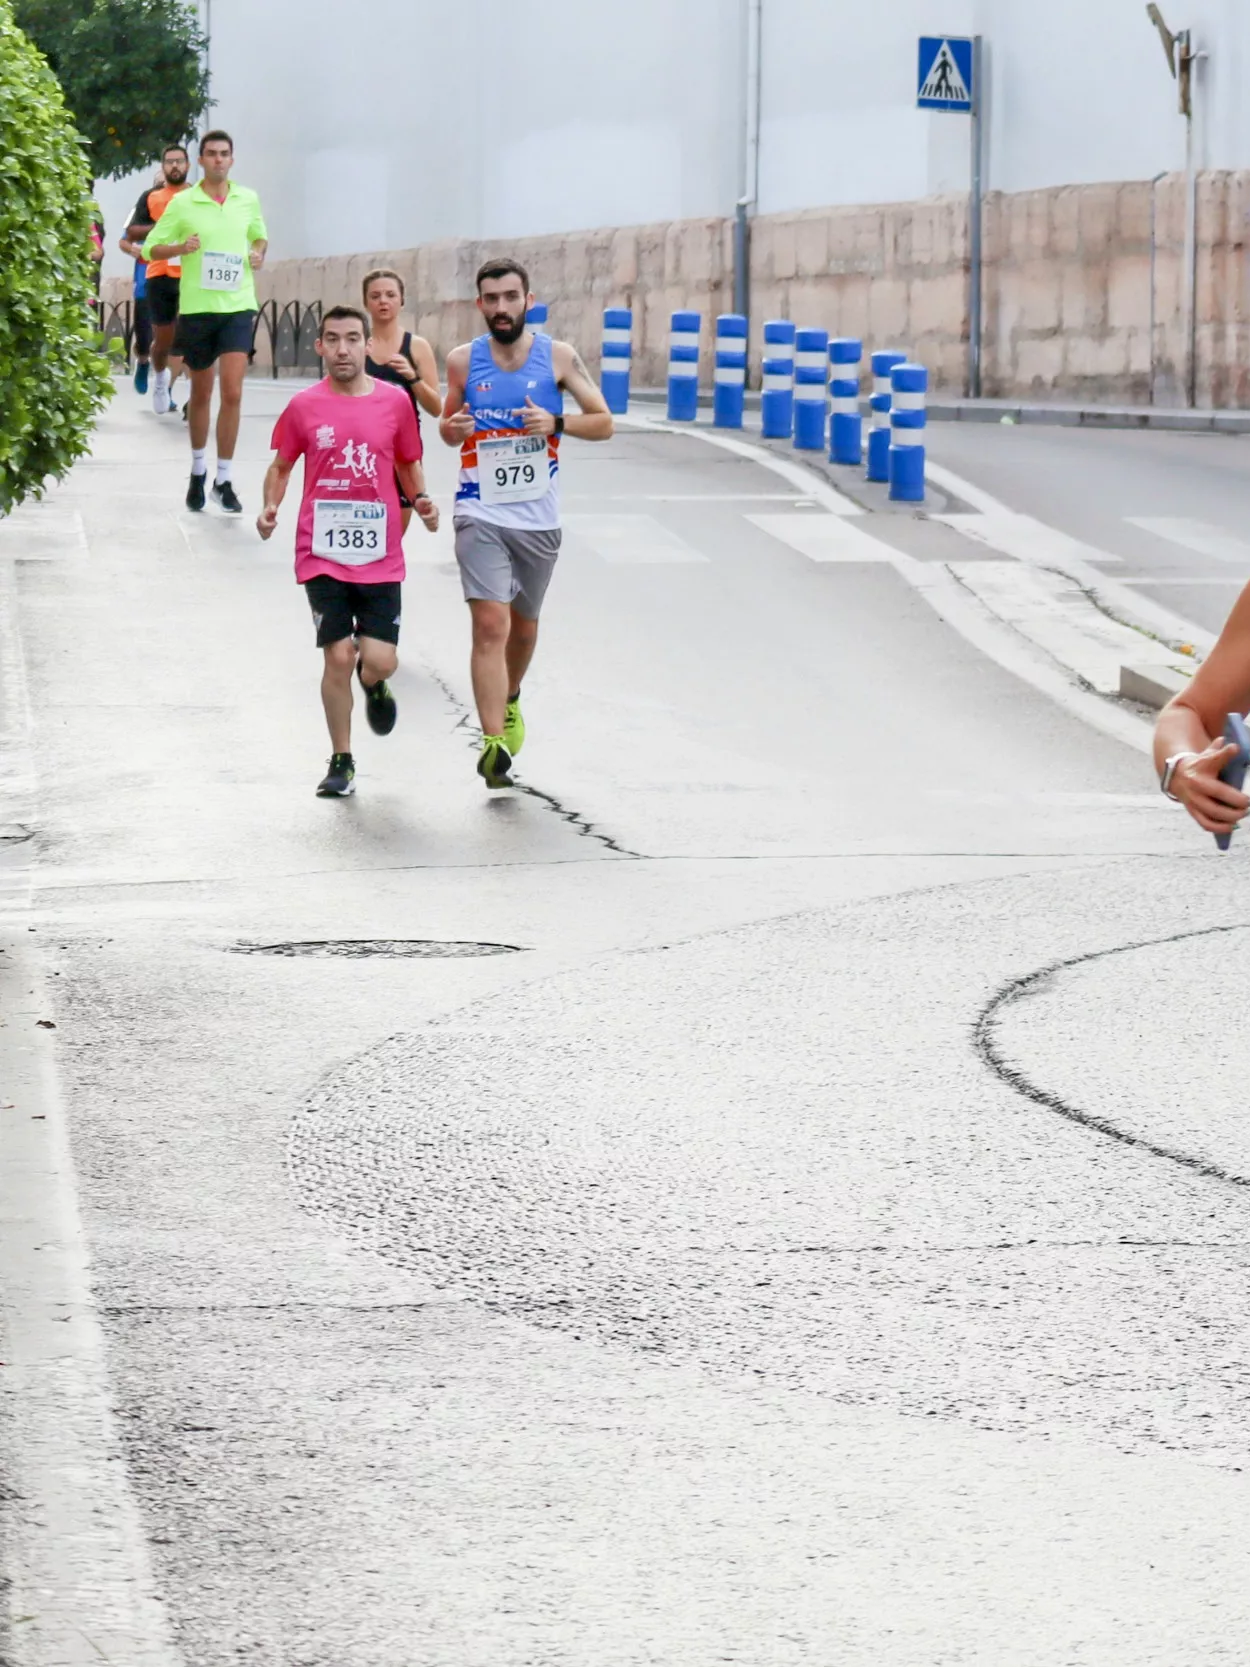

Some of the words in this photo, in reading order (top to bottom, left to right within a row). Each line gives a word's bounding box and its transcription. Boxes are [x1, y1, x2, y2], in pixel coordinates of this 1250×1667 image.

[208, 268, 239, 282] 1387
[495, 464, 535, 487] 979
[325, 529, 378, 549] 1383
